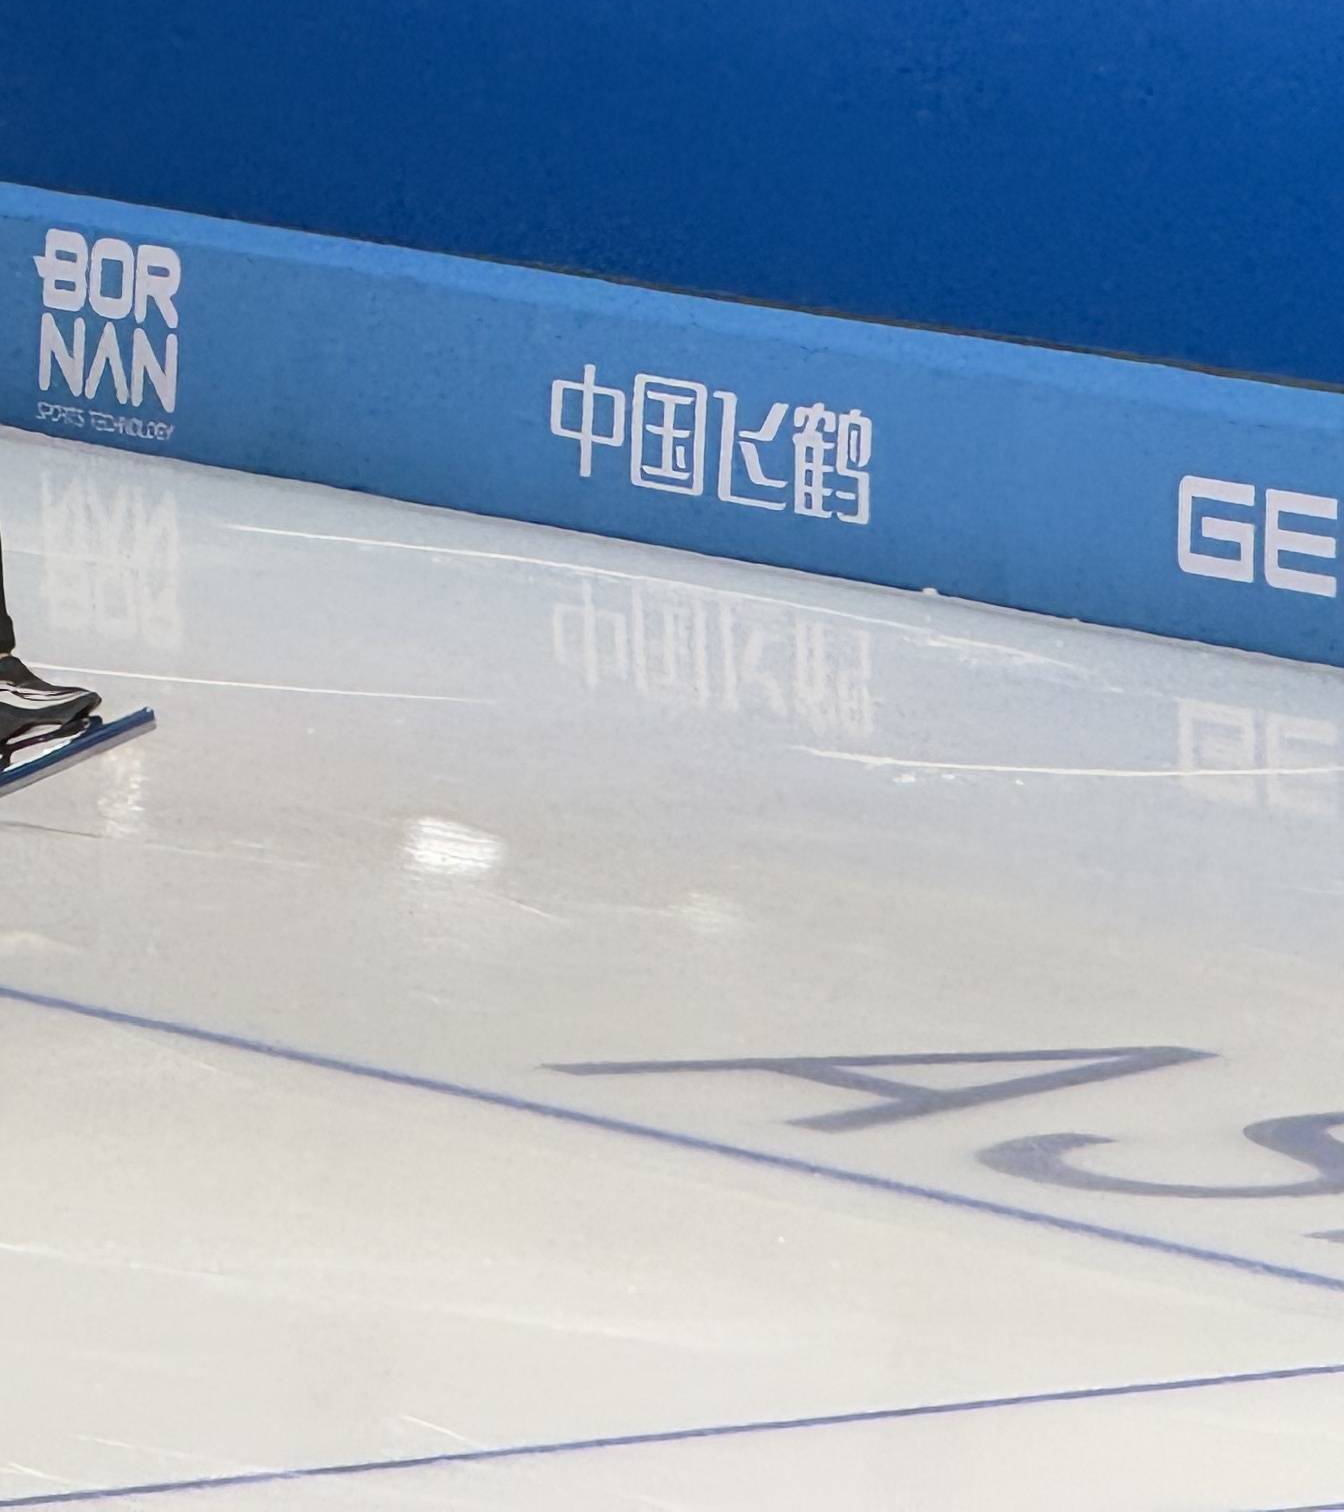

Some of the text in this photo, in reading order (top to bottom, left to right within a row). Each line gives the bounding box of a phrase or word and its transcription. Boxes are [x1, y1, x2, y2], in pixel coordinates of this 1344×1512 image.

[33, 228, 182, 329] BOR
[38, 312, 179, 414] NAN
[551, 364, 872, 525] 中国飞鹤
